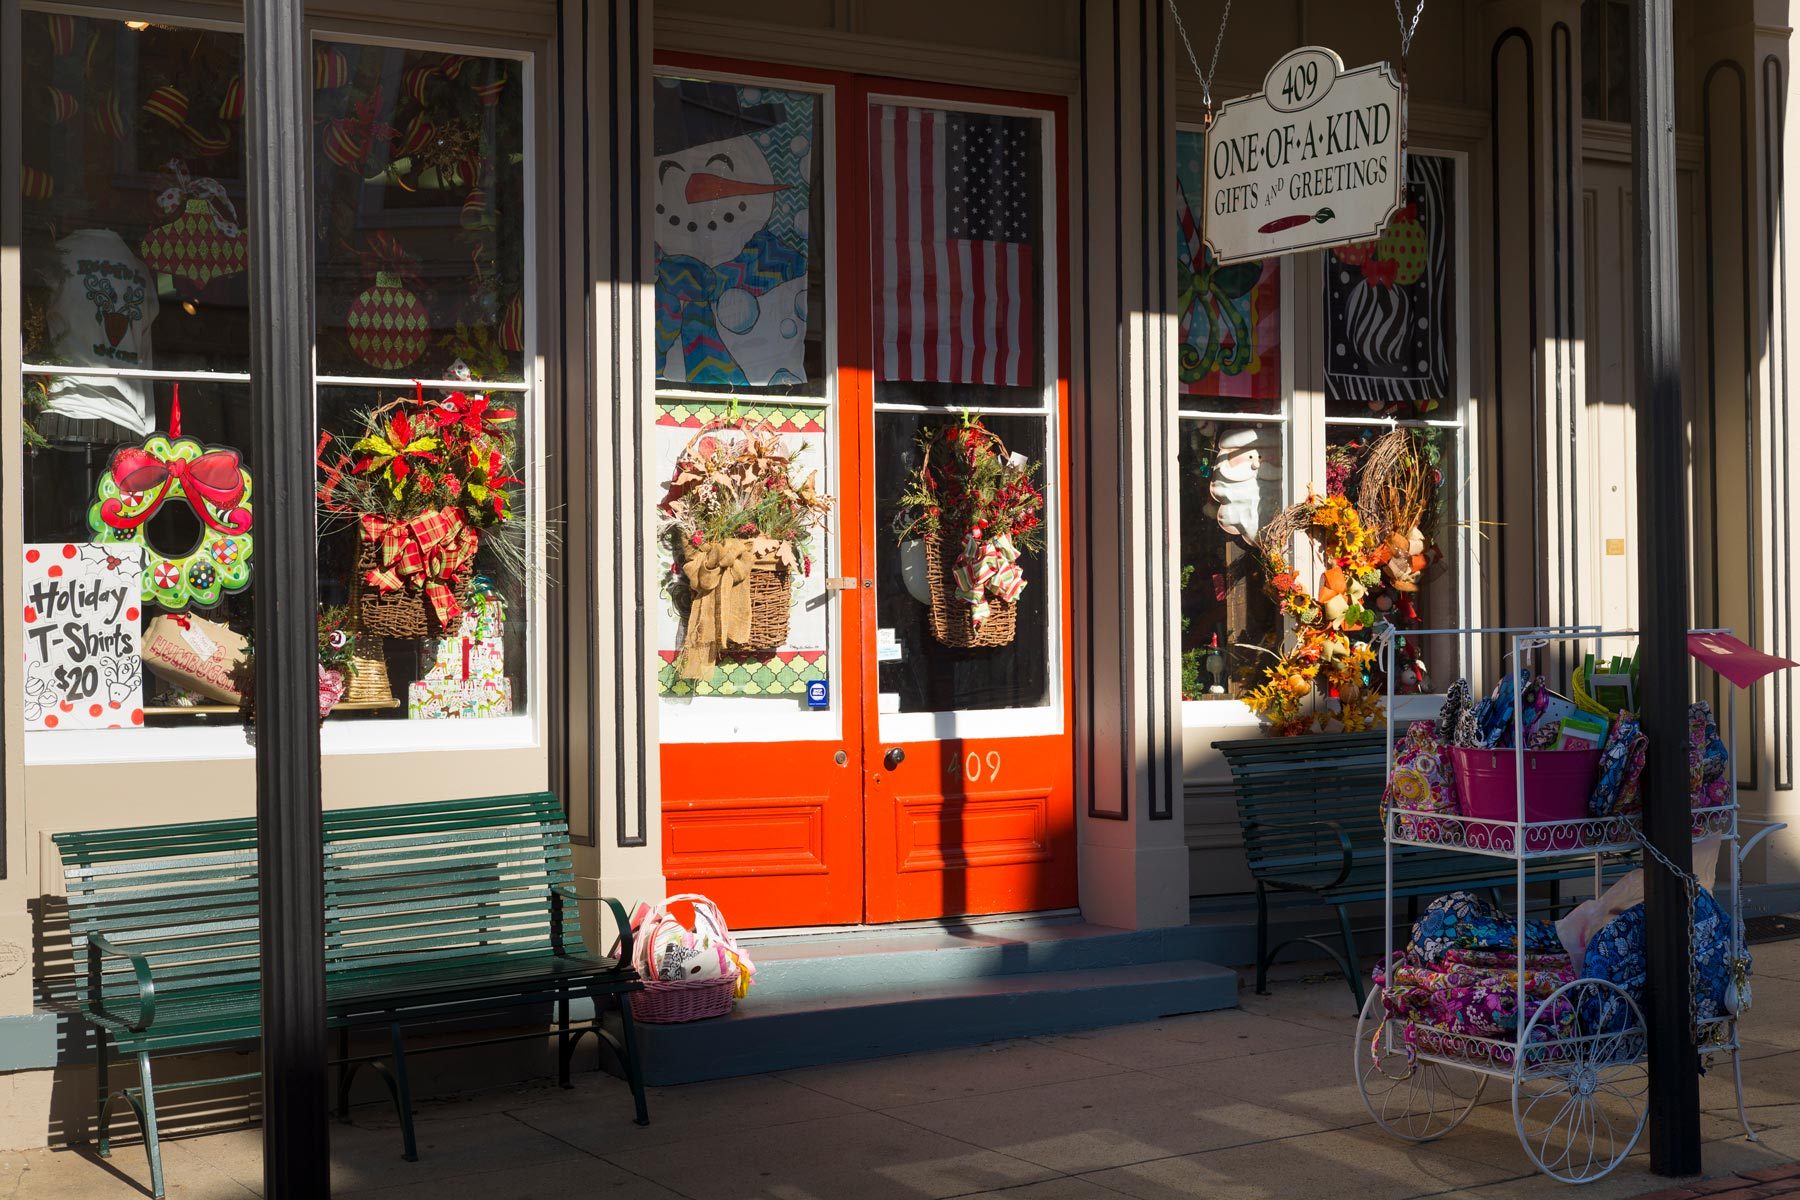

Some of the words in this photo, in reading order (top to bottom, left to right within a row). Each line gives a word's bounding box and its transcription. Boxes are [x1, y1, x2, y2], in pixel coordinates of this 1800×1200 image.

[1282, 61, 1318, 105] 409
[1214, 182, 1259, 216] GIFTS
[1264, 177, 1285, 207] AND
[1289, 155, 1388, 201] GREETINGS
[29, 579, 128, 624] Holiday
[28, 622, 134, 664] T-Shirts
[54, 664, 98, 701] $20
[947, 750, 1001, 784] 409
